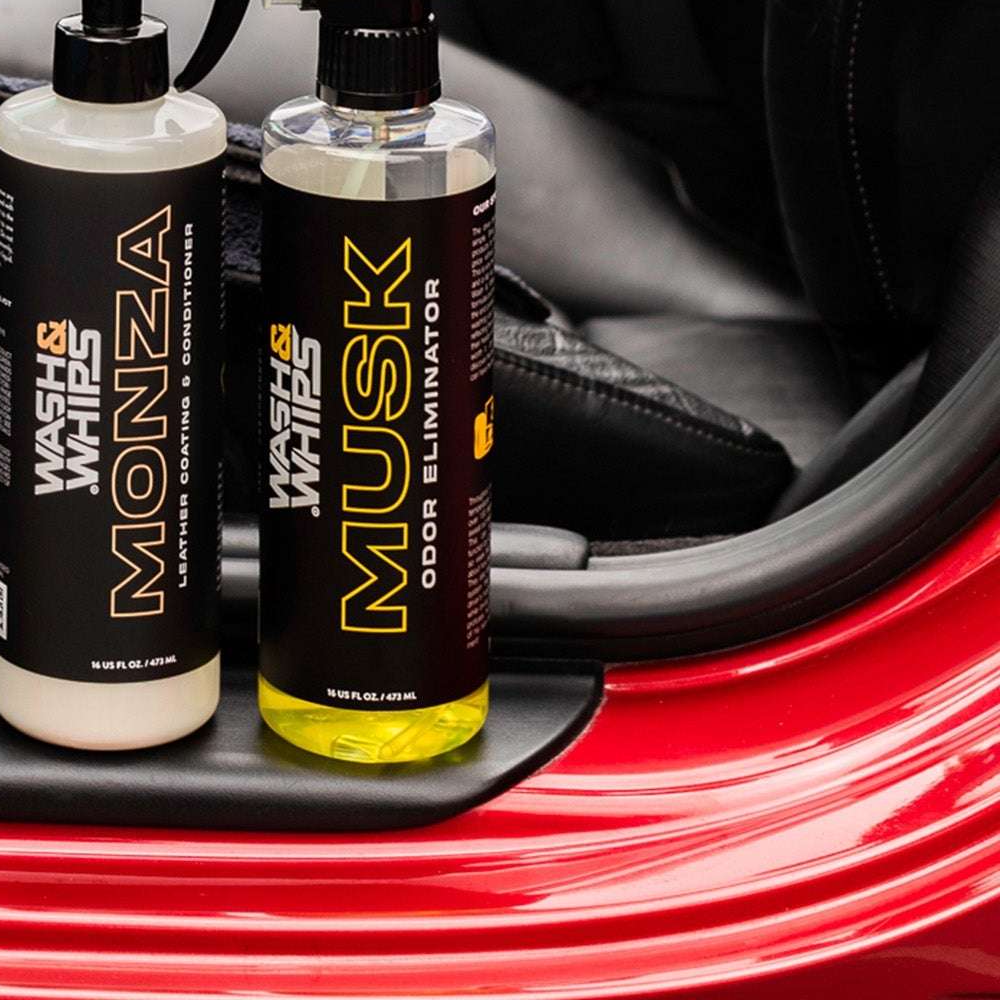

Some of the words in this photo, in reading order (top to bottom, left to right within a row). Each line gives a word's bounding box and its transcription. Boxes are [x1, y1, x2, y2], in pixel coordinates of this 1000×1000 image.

[181, 222, 194, 369] CONDITIONER
[66, 317, 102, 493] WHIPS
[111, 204, 172, 618] MONZA
[179, 396, 191, 487] COATING
[182, 375, 191, 388] &
[291, 323, 322, 509] WHIPS
[341, 235, 412, 633] MUSK
[423, 278, 441, 485] ELIMINATOR
[177, 490, 190, 588] LEATHER
[421, 499, 438, 590] ODOR
[91, 660, 101, 670] 16
[102, 660, 115, 670] US
[116, 660, 127, 670] FL
[149, 657, 164, 666] 473
[165, 654, 177, 664] ML
[326, 688, 337, 698] 16
[337, 689, 350, 699] US
[351, 691, 362, 701] FL
[386, 692, 402, 701] 473
[403, 691, 417, 700] ML
